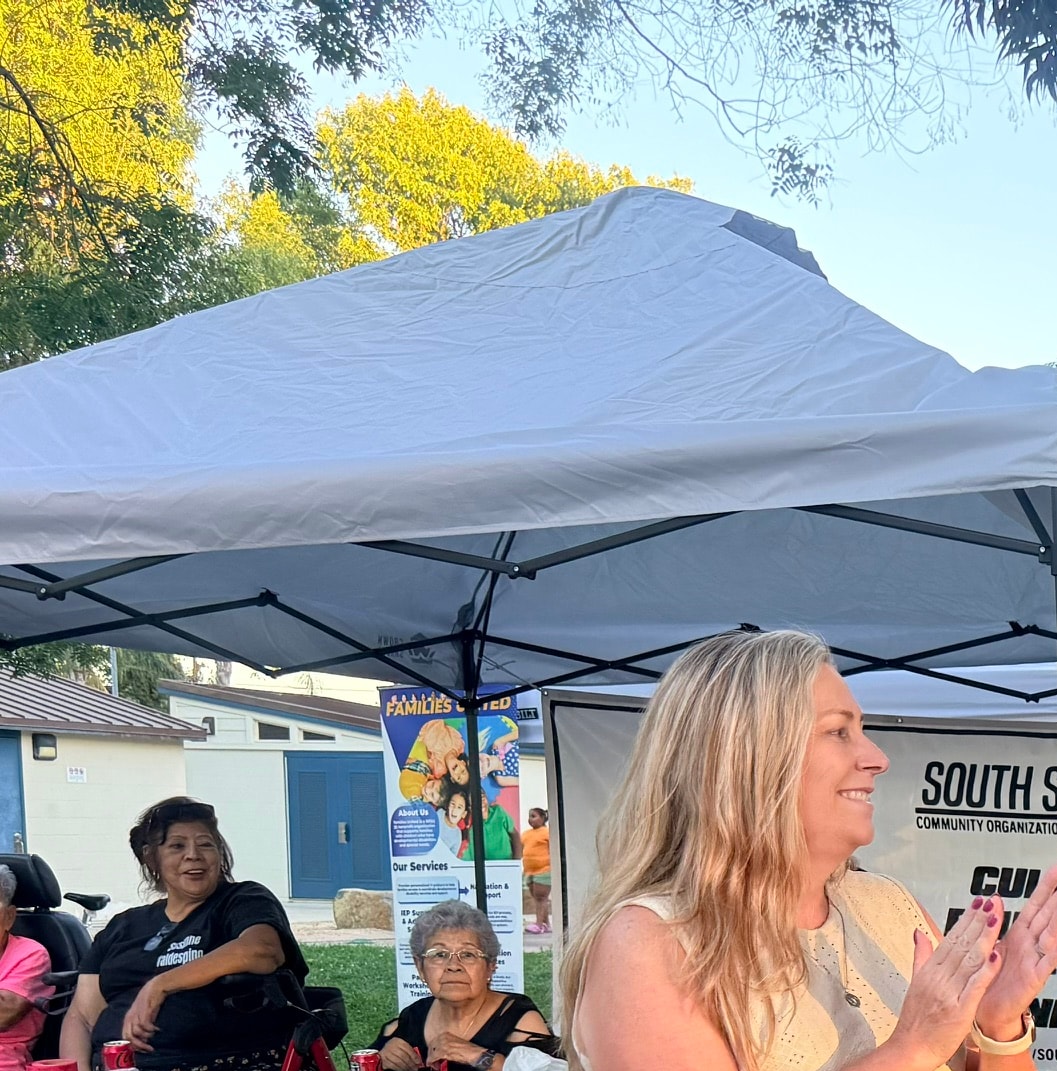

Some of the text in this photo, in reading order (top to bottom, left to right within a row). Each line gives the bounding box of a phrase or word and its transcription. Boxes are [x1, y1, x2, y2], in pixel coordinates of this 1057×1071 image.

[386, 698, 452, 717] FAMILIES
[922, 761, 1034, 811] SOUTH
[398, 809, 419, 817] About
[916, 816, 984, 833] COMMUNITY
[393, 860, 448, 871] Our Services
